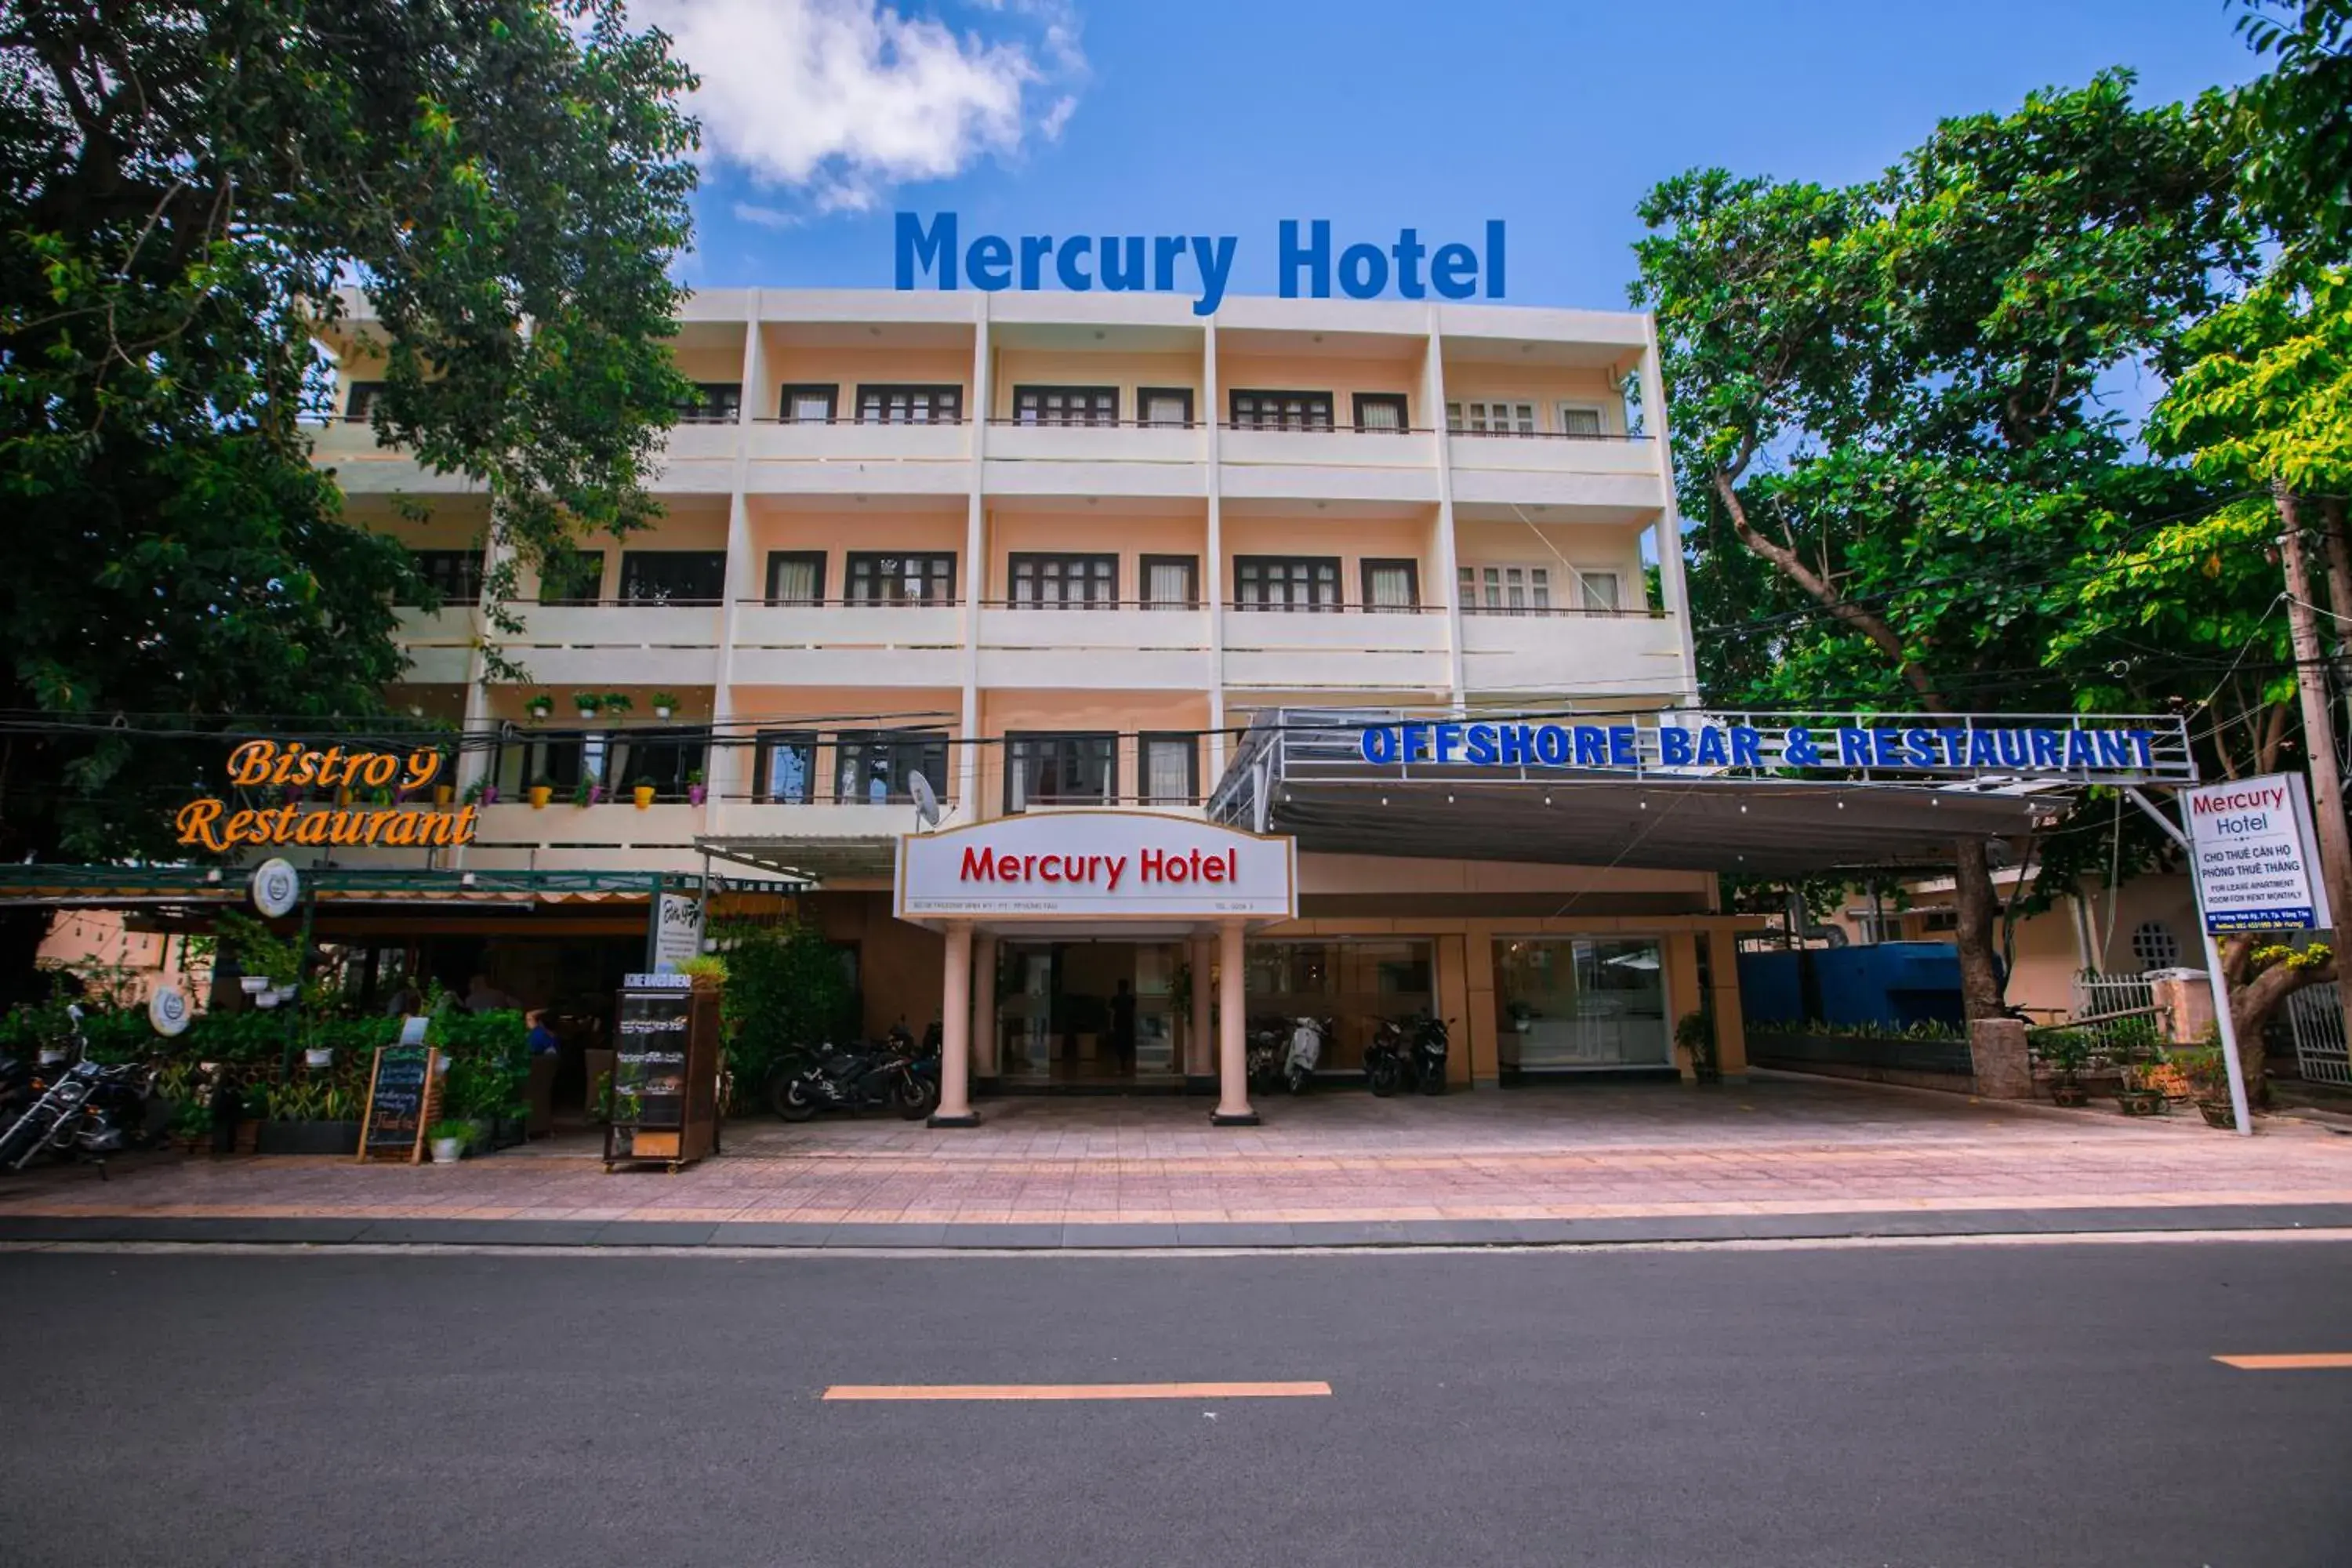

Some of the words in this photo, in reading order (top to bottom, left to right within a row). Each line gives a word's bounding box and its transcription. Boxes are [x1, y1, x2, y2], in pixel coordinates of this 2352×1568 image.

[895, 211, 1238, 316] Mercury
[1279, 219, 1506, 299] Hotel
[227, 739, 398, 786] Bistro
[1361, 724, 1637, 765] OFFSHORE
[1659, 725, 1762, 766] BAR
[1784, 726, 1821, 766] &
[1836, 727, 2155, 768] RESTAURANT
[2193, 787, 2285, 815] Mercury
[176, 799, 479, 852] Restaurant
[2216, 812, 2268, 836] Hotel
[960, 846, 1127, 891] Mercury
[1140, 847, 1236, 884] Hotel
[2204, 851, 2224, 862] CHO
